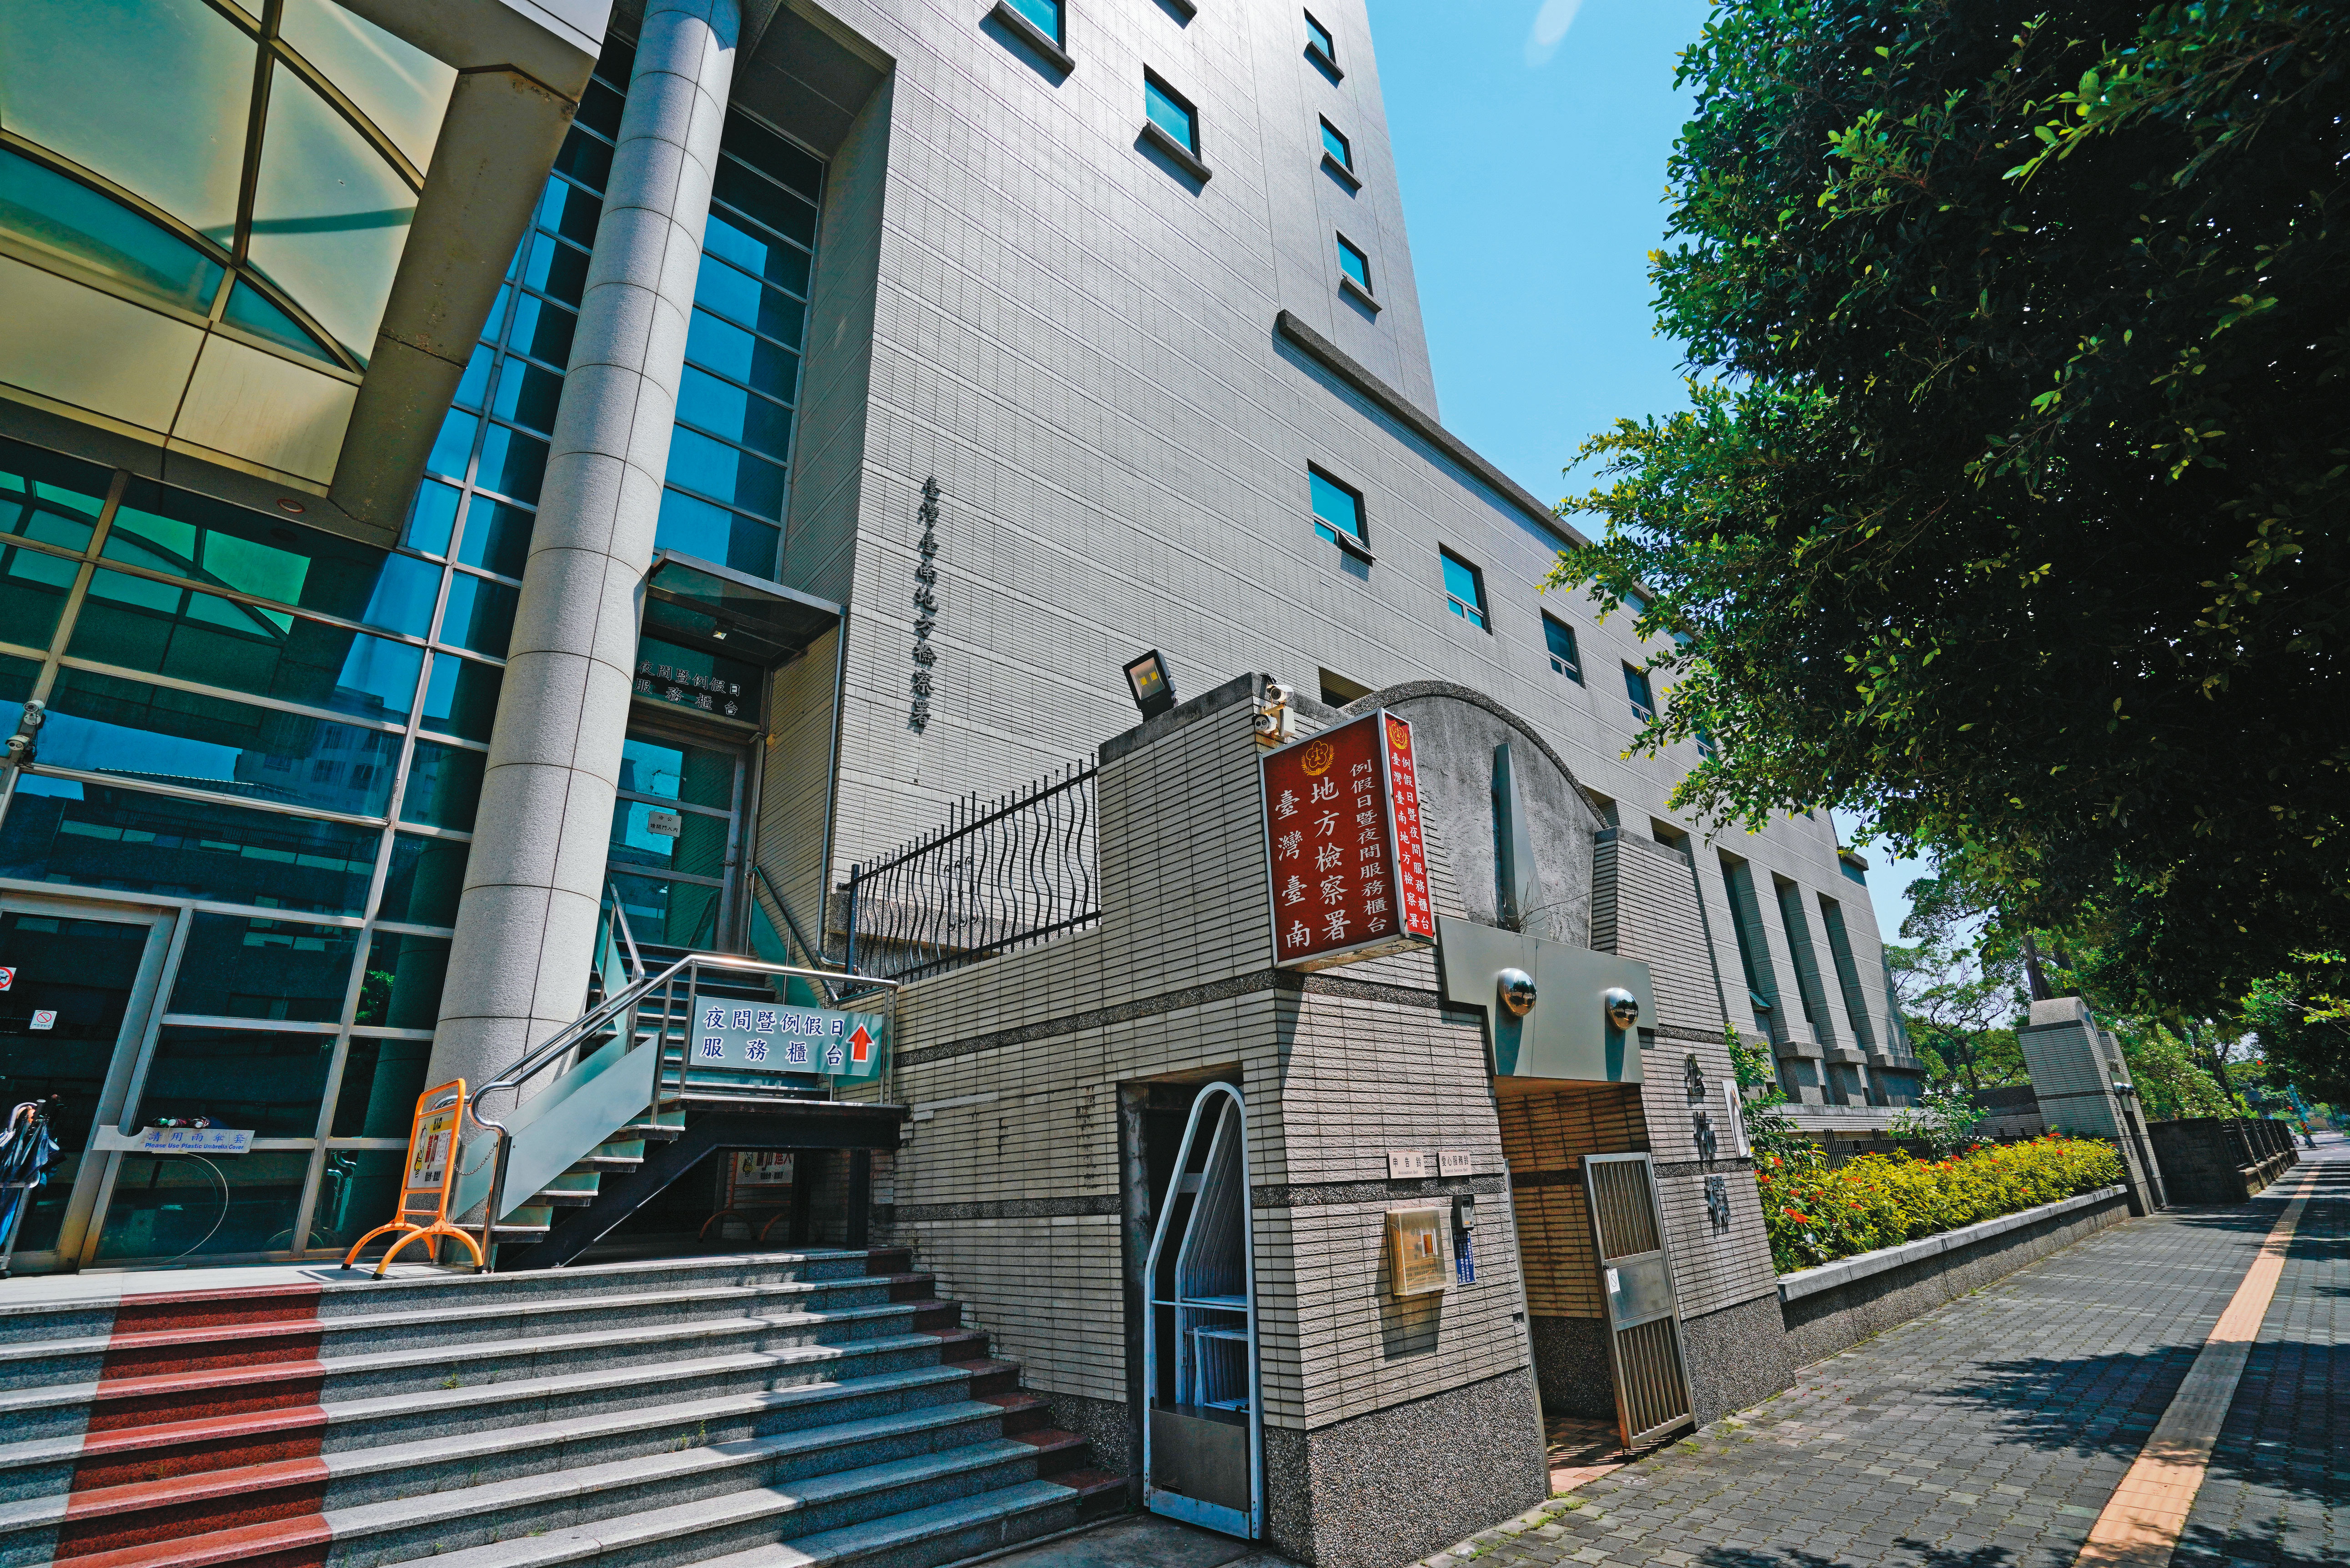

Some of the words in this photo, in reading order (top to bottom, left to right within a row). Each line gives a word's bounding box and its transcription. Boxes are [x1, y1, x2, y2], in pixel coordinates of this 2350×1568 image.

[910, 476, 941, 727] 臺灣臺南地方檢察署
[638, 659, 740, 696] 夜間暨例假日
[633, 678, 738, 716] 服務櫃台
[650, 823, 678, 833] 請開門入內
[1350, 759, 1388, 933] 例假日暨夜間服務櫃台
[1391, 752, 1419, 928] 臺灣臺南地方檢察署
[1401, 757, 1429, 930] 例假日暨夜間服務櫃台
[1275, 790, 1310, 948] 臺灣臺南
[1310, 777, 1351, 940] 地方檢察署
[703, 1006, 844, 1037] 夜間暨例假日
[699, 1037, 844, 1066] 服務櫃台
[149, 1131, 245, 1144] 請用雨傘套
[1393, 1157, 1421, 1167] 申告鈴
[1441, 1156, 1469, 1166] 愛心服務鈴
